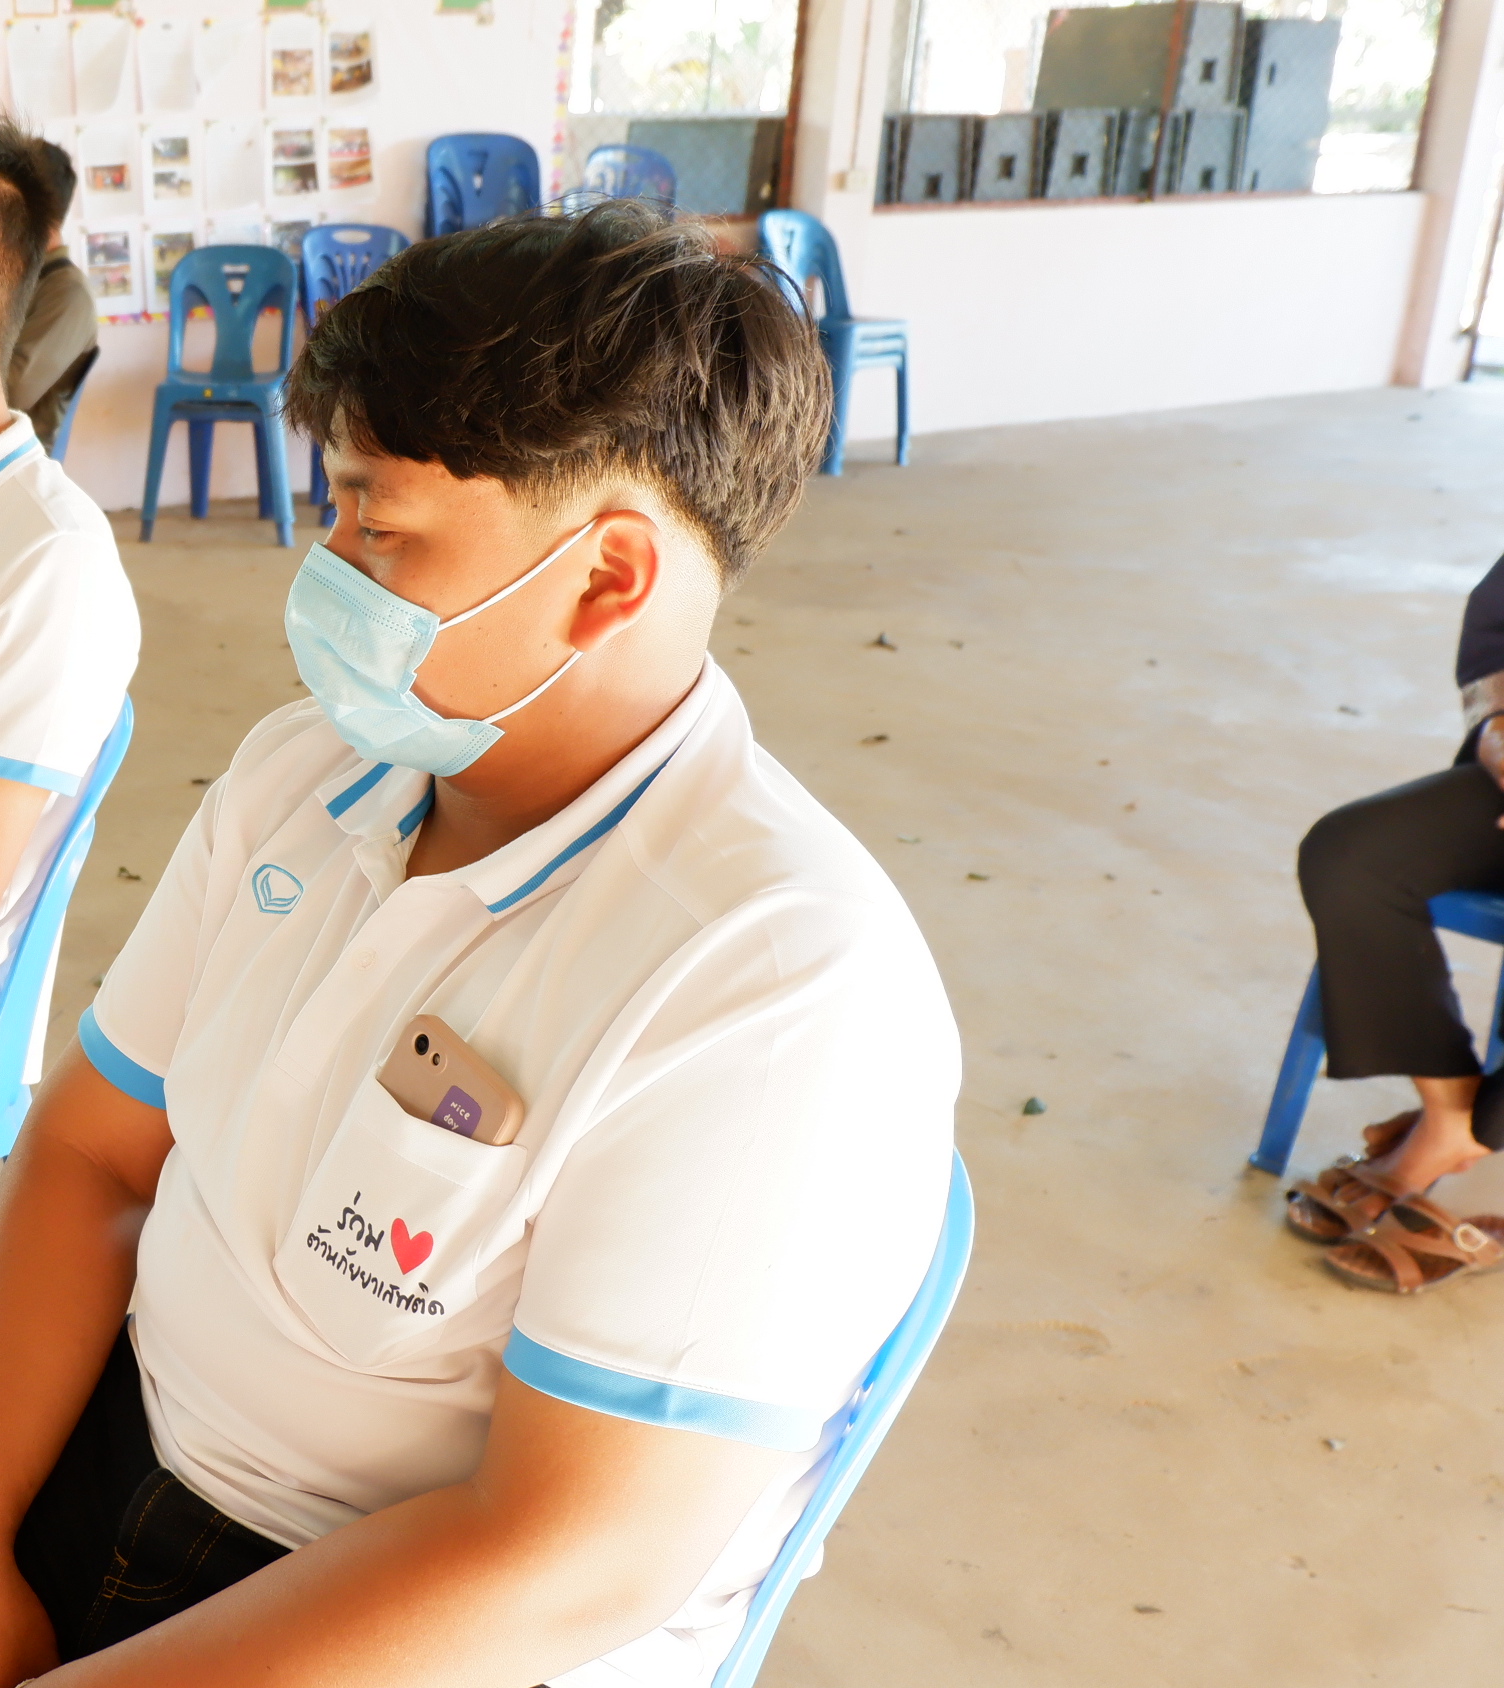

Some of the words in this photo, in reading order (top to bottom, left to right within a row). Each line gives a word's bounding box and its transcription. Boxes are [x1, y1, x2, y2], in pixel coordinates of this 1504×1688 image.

[443, 1113, 459, 1130] day
[337, 1190, 385, 1252] ร่วม
[307, 1224, 445, 1316] ต้านภัยยาเสพติด
